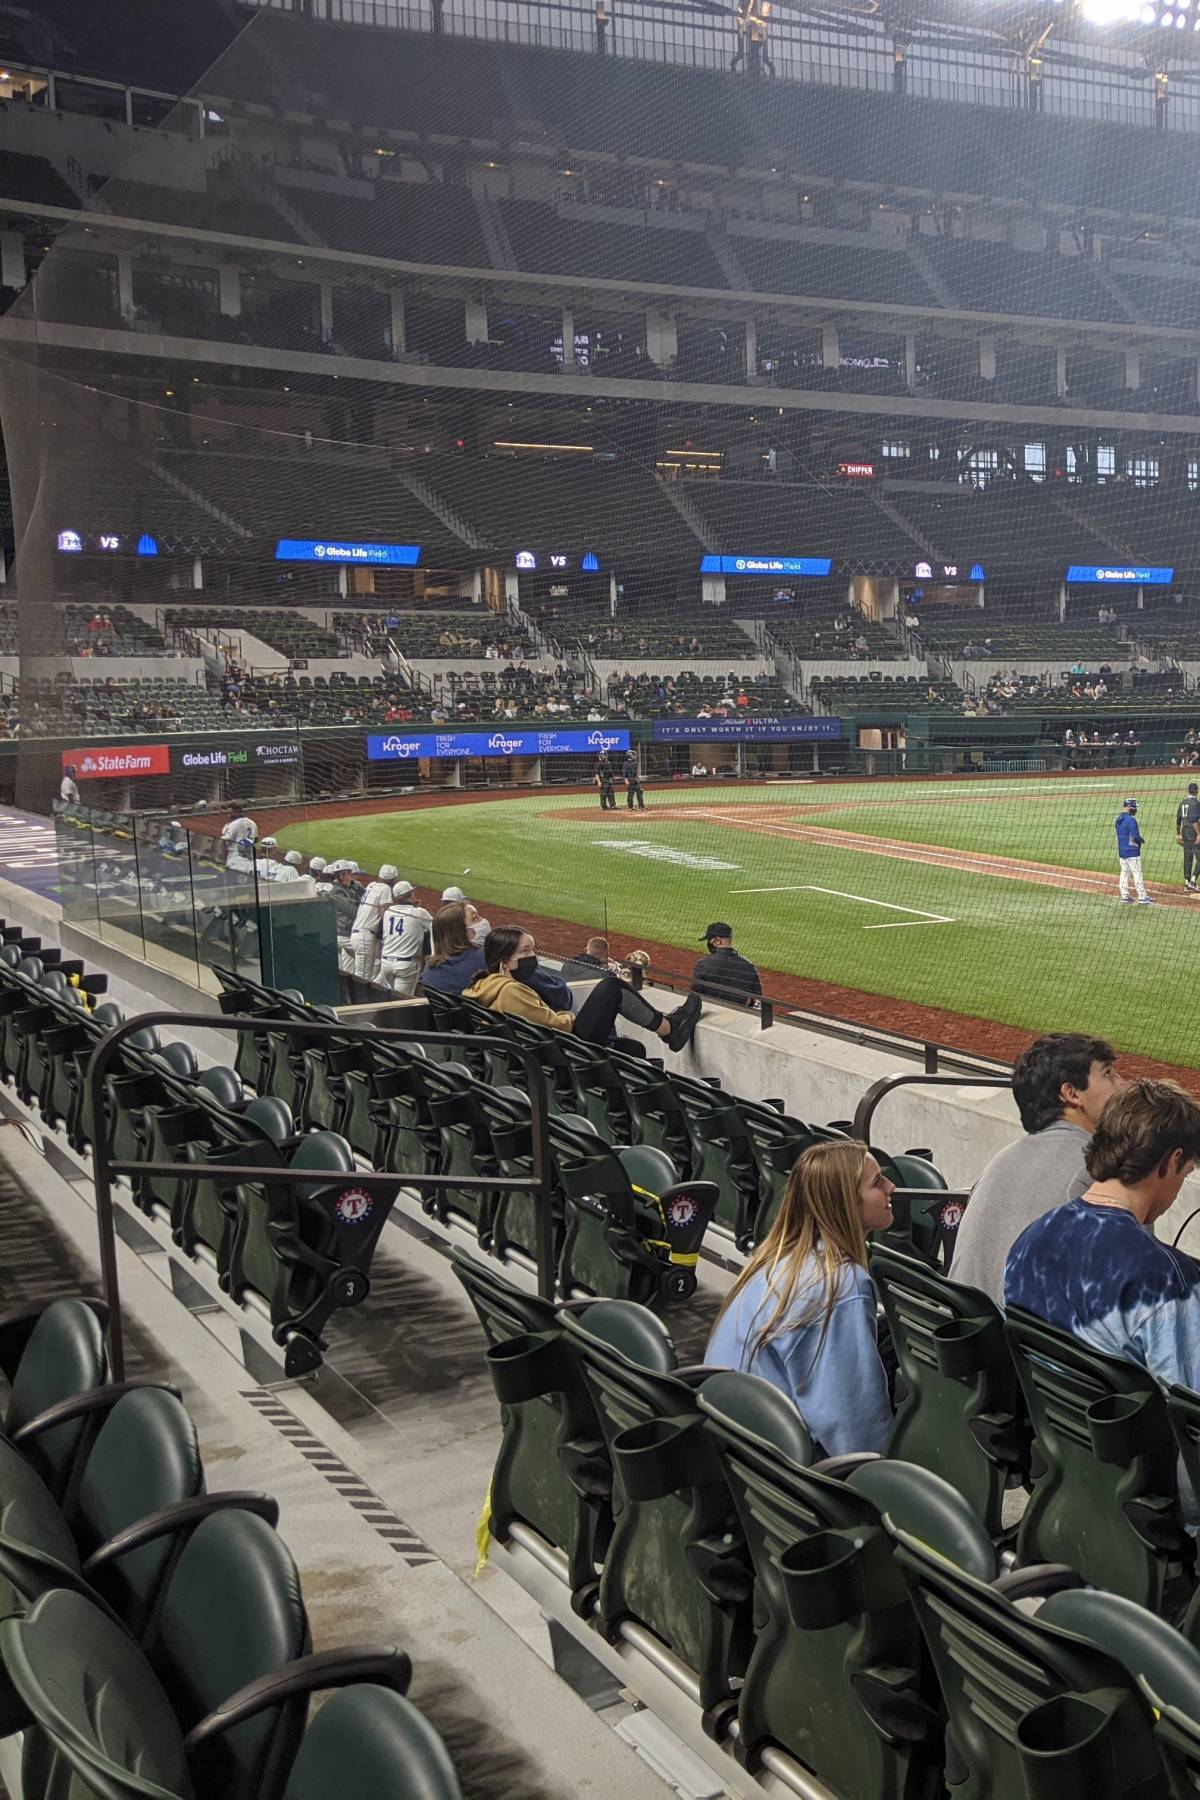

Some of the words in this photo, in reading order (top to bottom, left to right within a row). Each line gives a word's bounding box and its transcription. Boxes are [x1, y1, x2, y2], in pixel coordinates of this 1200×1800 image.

[100, 536, 119, 548] VS
[326, 546, 352, 557] Globe
[352, 548, 368, 557] Life
[550, 555, 567, 566] VS
[746, 561, 769, 569] Globe
[944, 566, 958, 576] VS
[752, 717, 779, 725] ULTRA
[383, 736, 421, 757] Kroger
[488, 733, 523, 754] Kroger
[587, 731, 620, 751] Kroger
[183, 753, 209, 766] Globe
[210, 751, 227, 764] Life
[227, 750, 248, 763] Field
[1181, 803, 1189, 818] 17
[388, 916, 405, 936] 14
[346, 1281, 354, 1296] 3
[677, 1279, 684, 1292] 2
